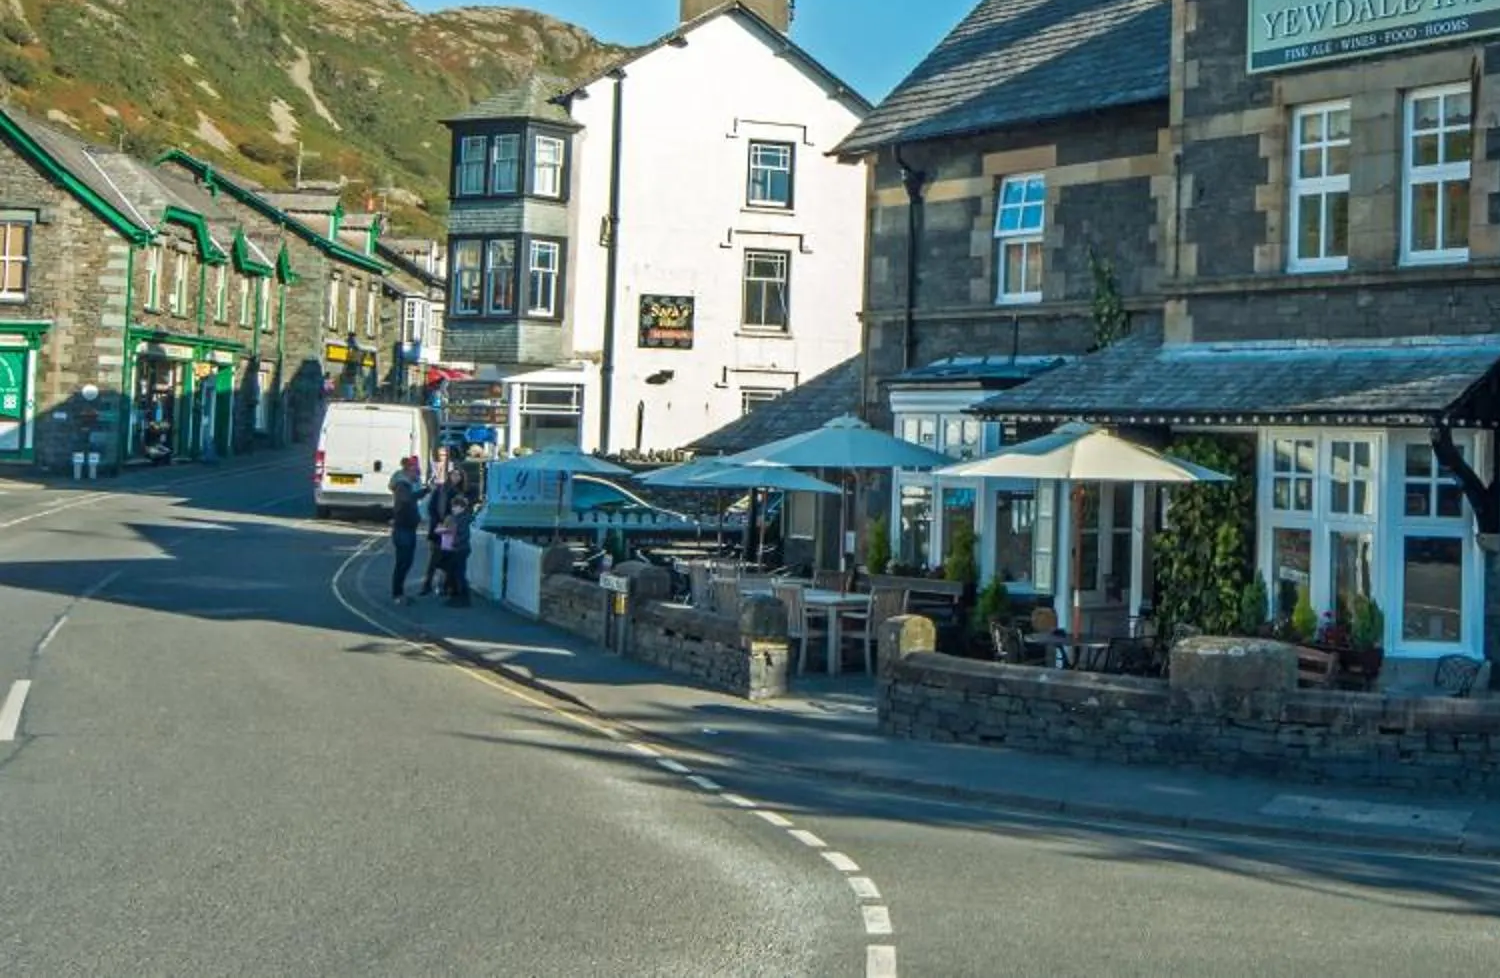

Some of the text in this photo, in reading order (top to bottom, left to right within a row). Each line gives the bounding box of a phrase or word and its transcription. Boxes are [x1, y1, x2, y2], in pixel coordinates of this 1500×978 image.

[1285, 46, 1308, 61] FINE
[1341, 34, 1377, 50] WINES
[1384, 27, 1417, 43] FOOD
[1425, 19, 1470, 37] ROOMS
